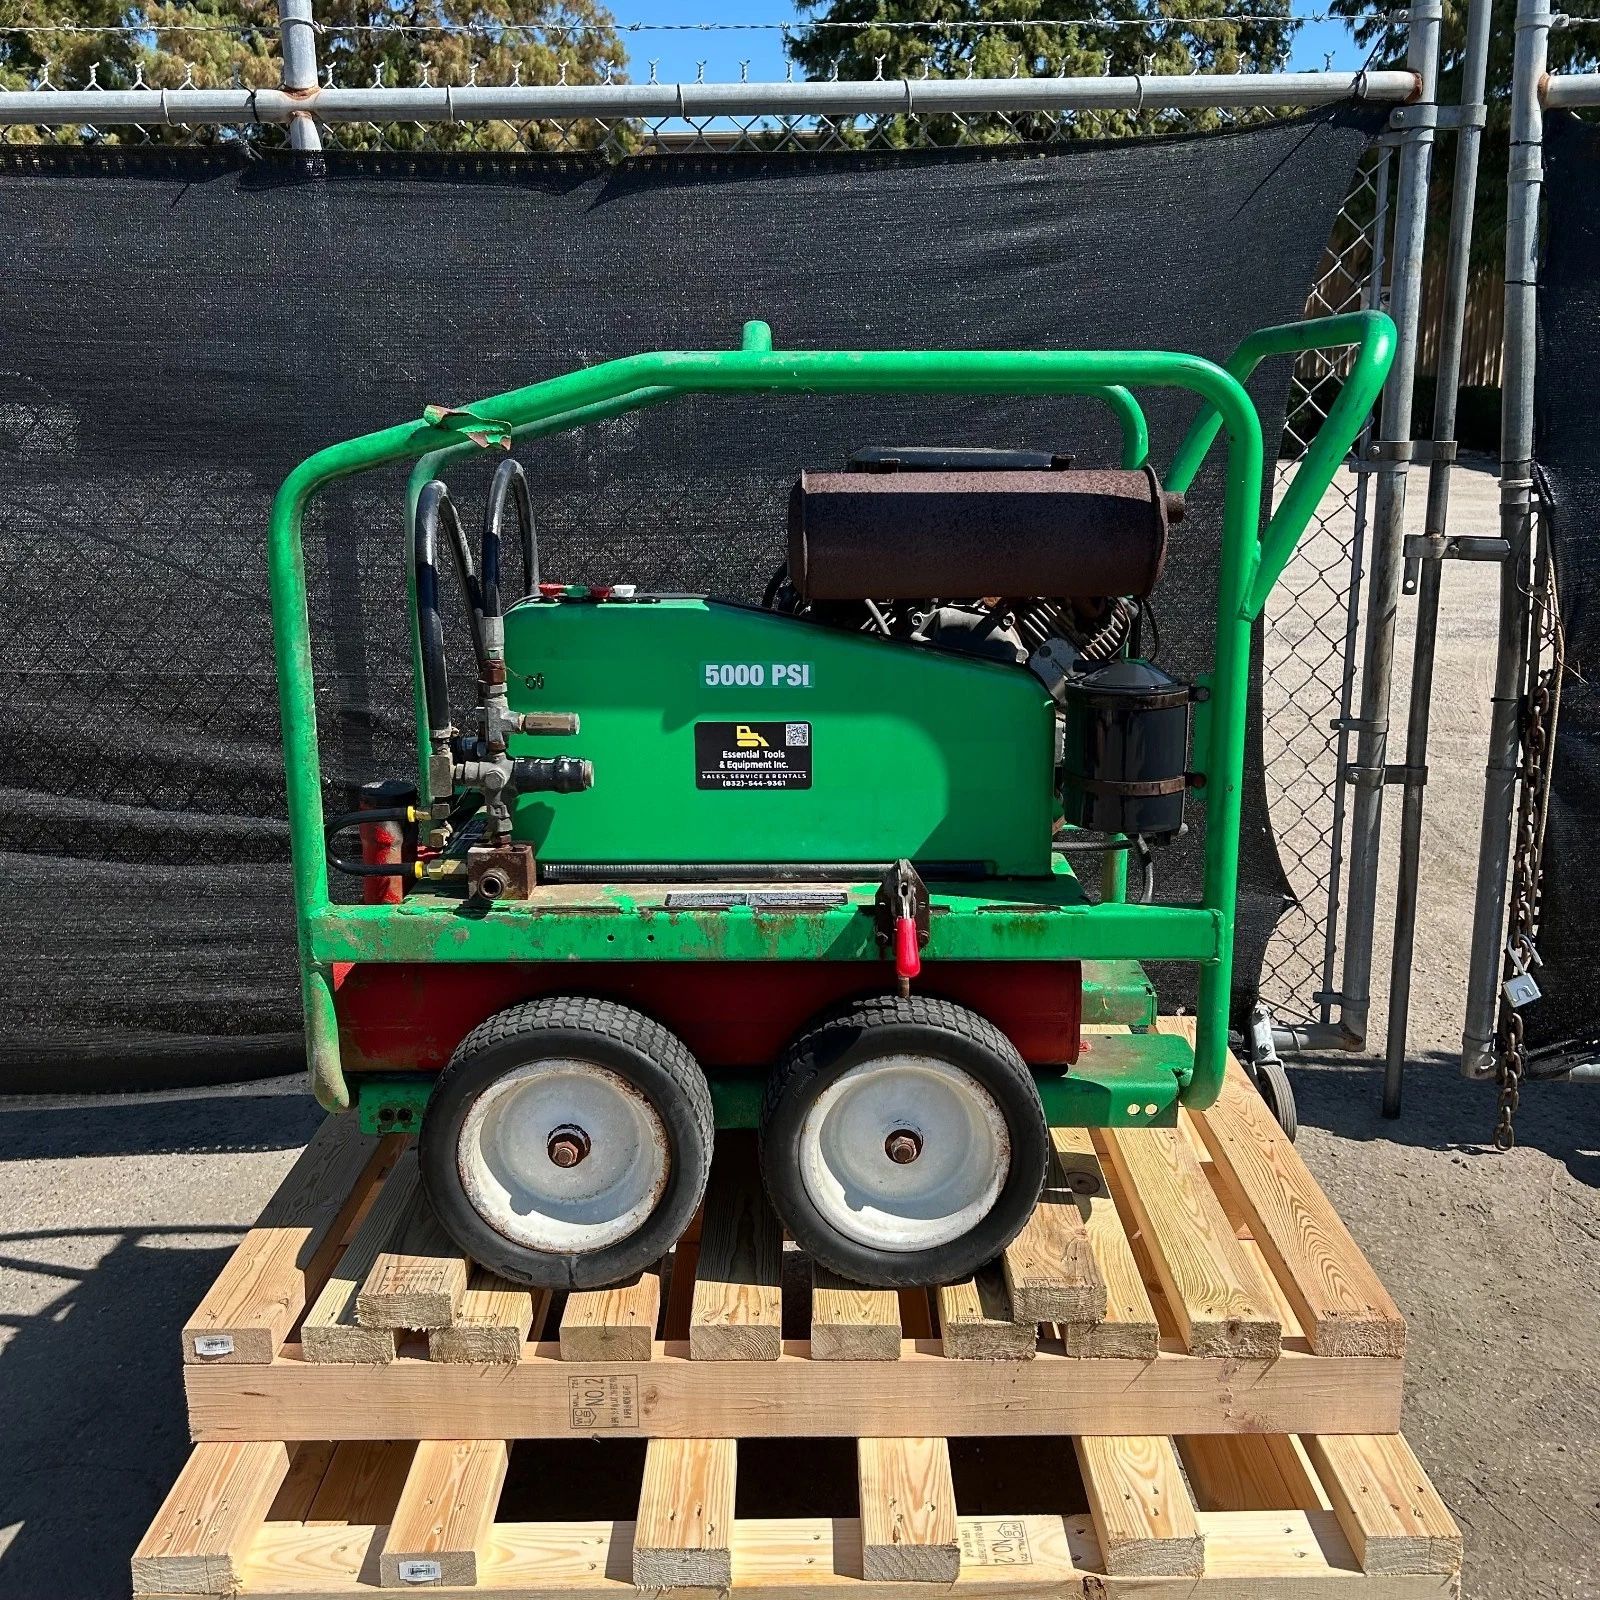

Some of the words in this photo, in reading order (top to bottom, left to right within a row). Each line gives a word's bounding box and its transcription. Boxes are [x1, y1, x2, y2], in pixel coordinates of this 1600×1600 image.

[705, 664, 765, 686] 5000
[771, 664, 810, 686] PSI
[722, 750, 760, 759] Essential
[763, 750, 786, 759] Tools
[719, 761, 726, 769] &
[727, 760, 772, 771] Equipment
[774, 760, 789, 769] Inc.
[584, 1386, 605, 1406] NO.
[575, 1410, 583, 1425] WC
[991, 1539, 1014, 1556] NO.
